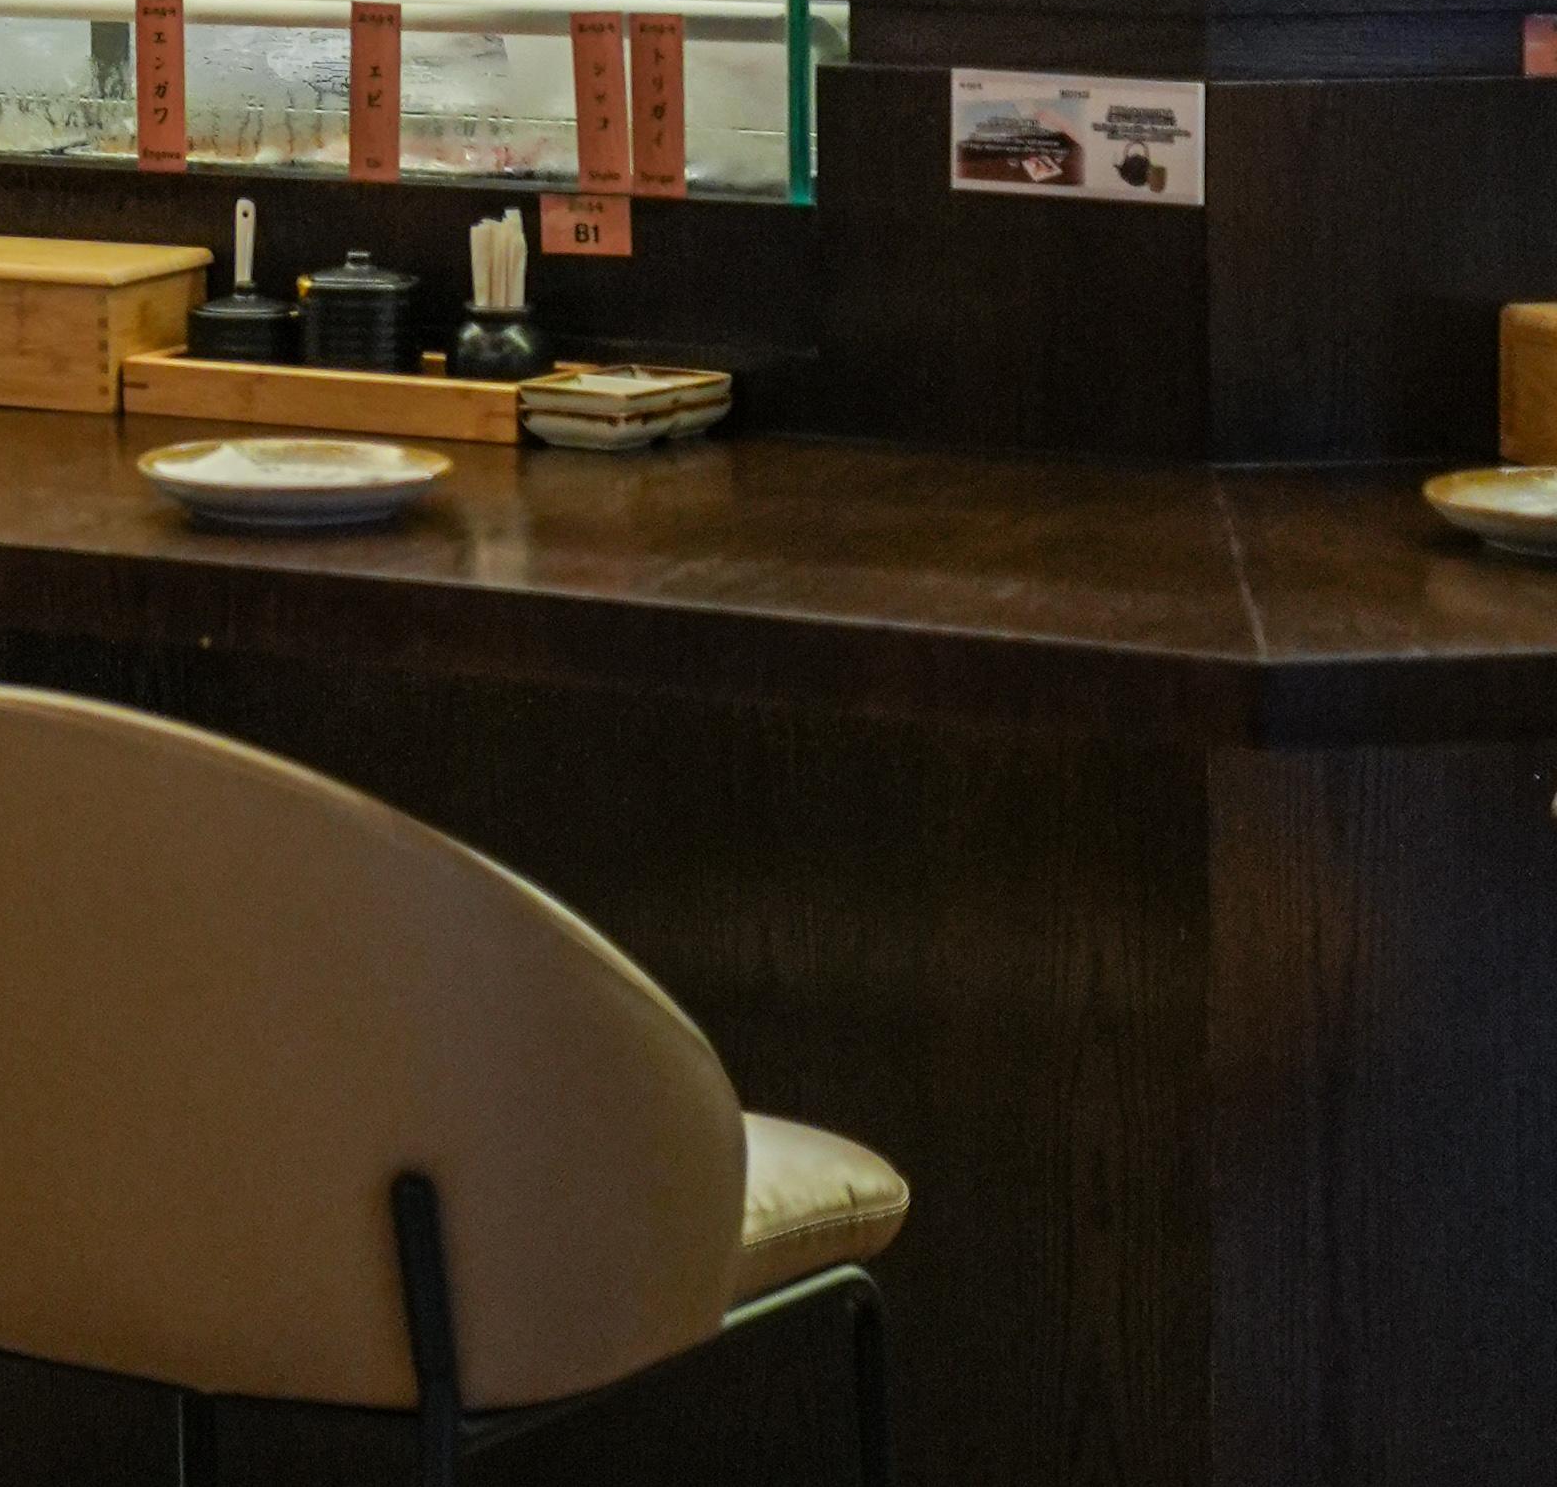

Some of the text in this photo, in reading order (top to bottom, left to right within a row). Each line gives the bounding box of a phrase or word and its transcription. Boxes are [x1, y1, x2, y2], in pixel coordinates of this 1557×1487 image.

[153, 31, 169, 125] エンガワ
[573, 223, 601, 244] B1
